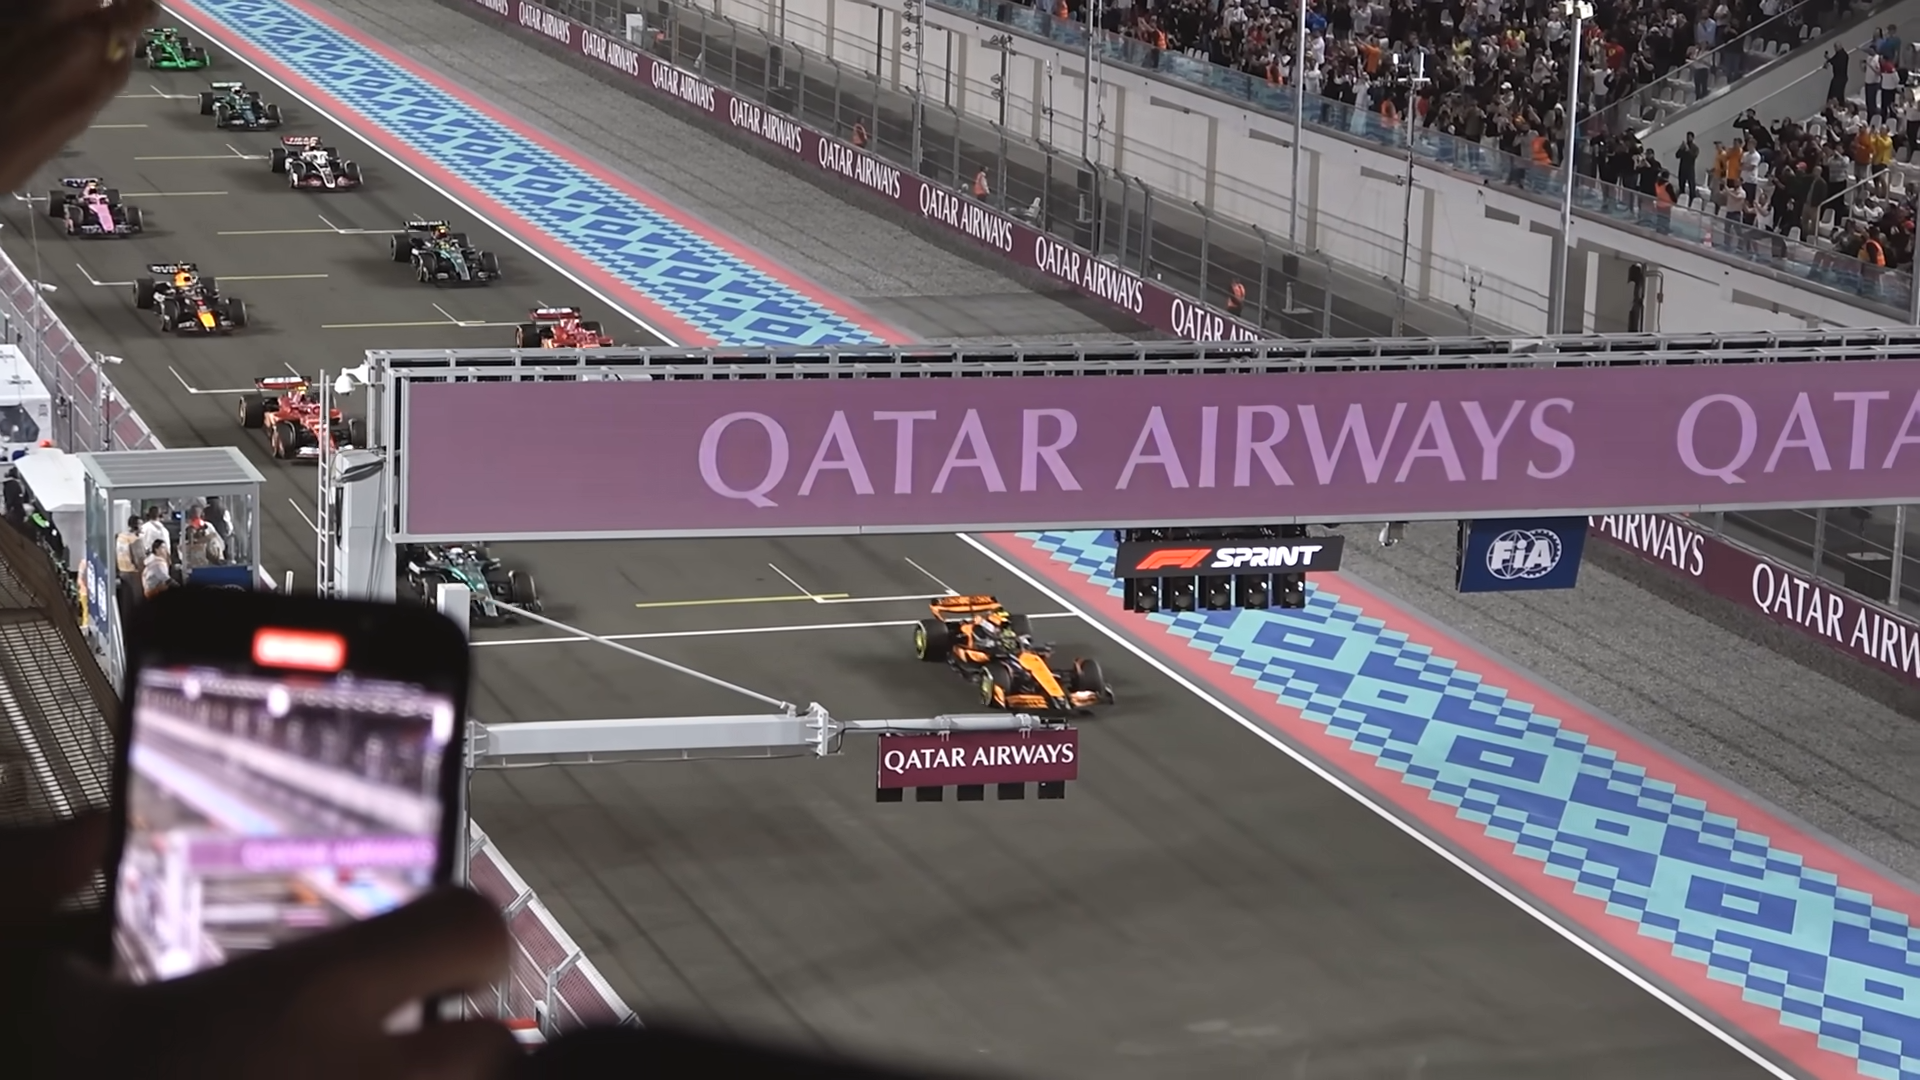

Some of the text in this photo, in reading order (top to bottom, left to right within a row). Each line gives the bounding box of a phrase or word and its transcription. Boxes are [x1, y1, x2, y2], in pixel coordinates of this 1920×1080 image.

[519, 2, 570, 44] QATAR AIRWAYS
[582, 29, 638, 76] QATAR AIRWAYS
[651, 61, 715, 112] QATAR AIRWAYS
[729, 97, 801, 153] QATAR AIRWAYS
[818, 137, 900, 199] QATAR AIRWAYS
[919, 183, 1013, 252] QATAR AIRWAYS
[1035, 236, 1143, 313] QATAR AIRWAYS
[1171, 299, 1224, 341] QATAR
[698, 397, 1576, 508] QATAR AIRWAYS
[1210, 545, 1323, 568] SPRINT
[1752, 563, 1843, 643] QATAR
[884, 743, 1074, 774] QATAR AIRWAYS
